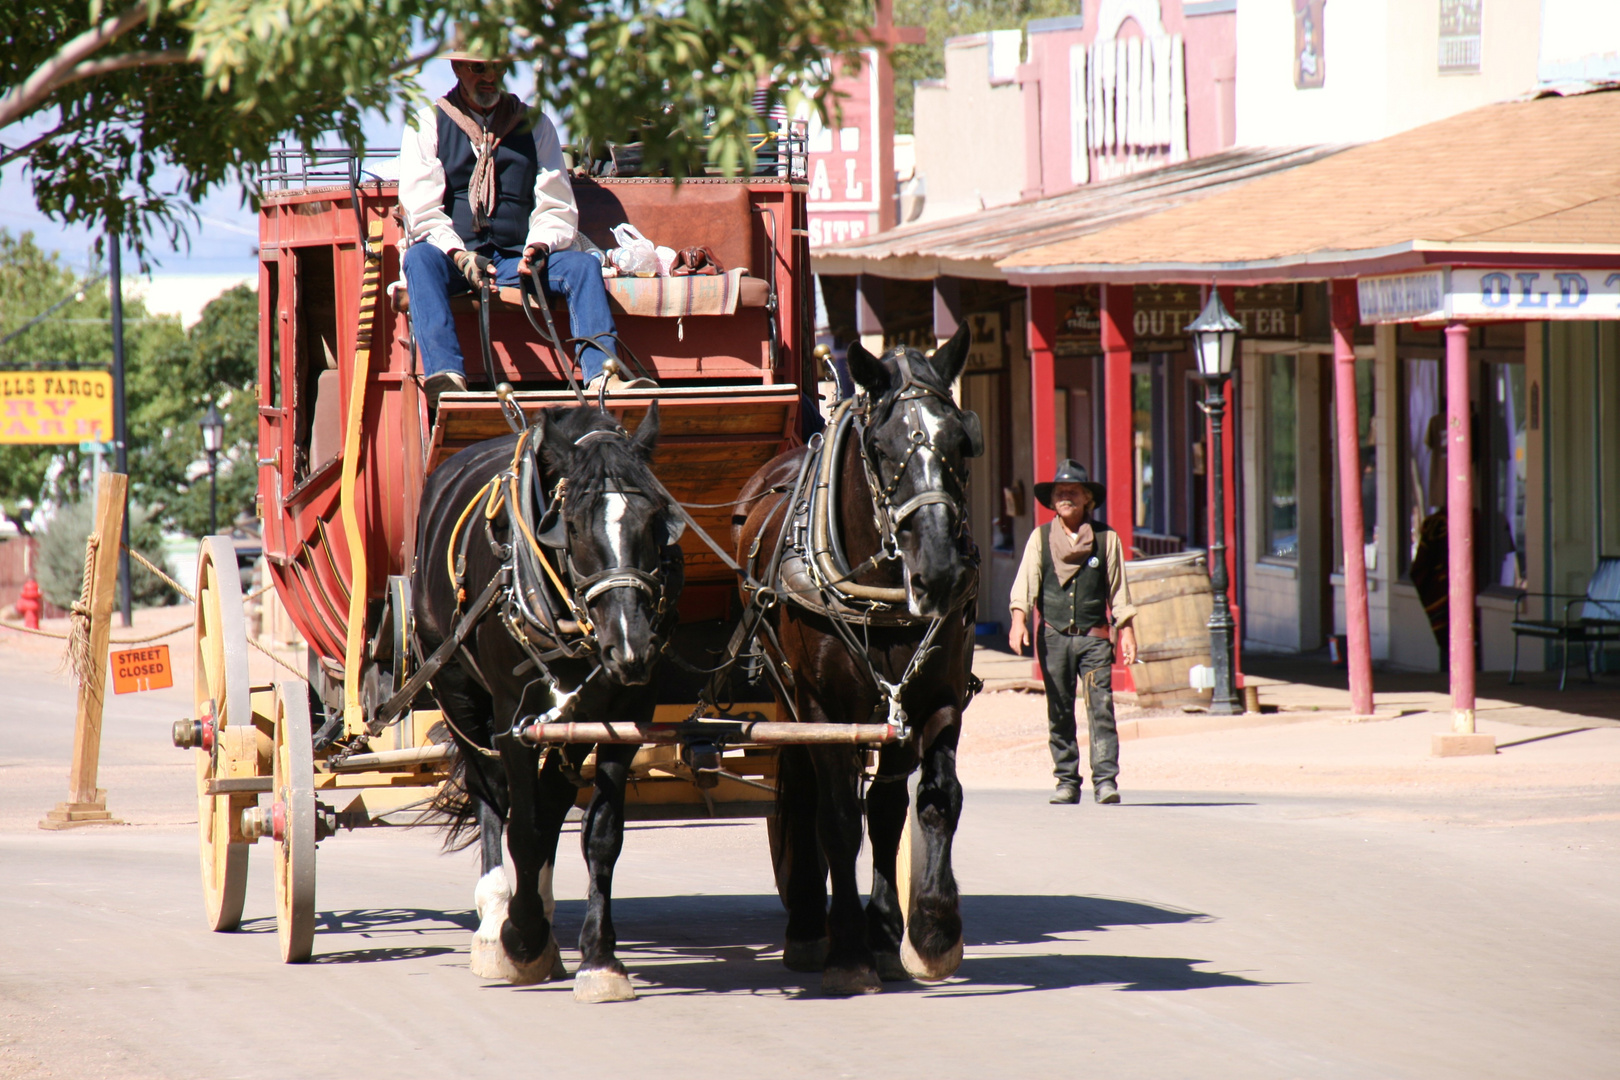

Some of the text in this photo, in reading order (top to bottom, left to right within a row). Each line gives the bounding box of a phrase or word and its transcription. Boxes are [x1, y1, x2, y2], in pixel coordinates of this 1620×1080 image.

[1480, 271, 1589, 308] OLD
[1132, 307, 1287, 337] OUTFTER
[45, 377, 105, 398] FARGO
[118, 649, 161, 664] STREET
[119, 663, 164, 678] CLOSED
